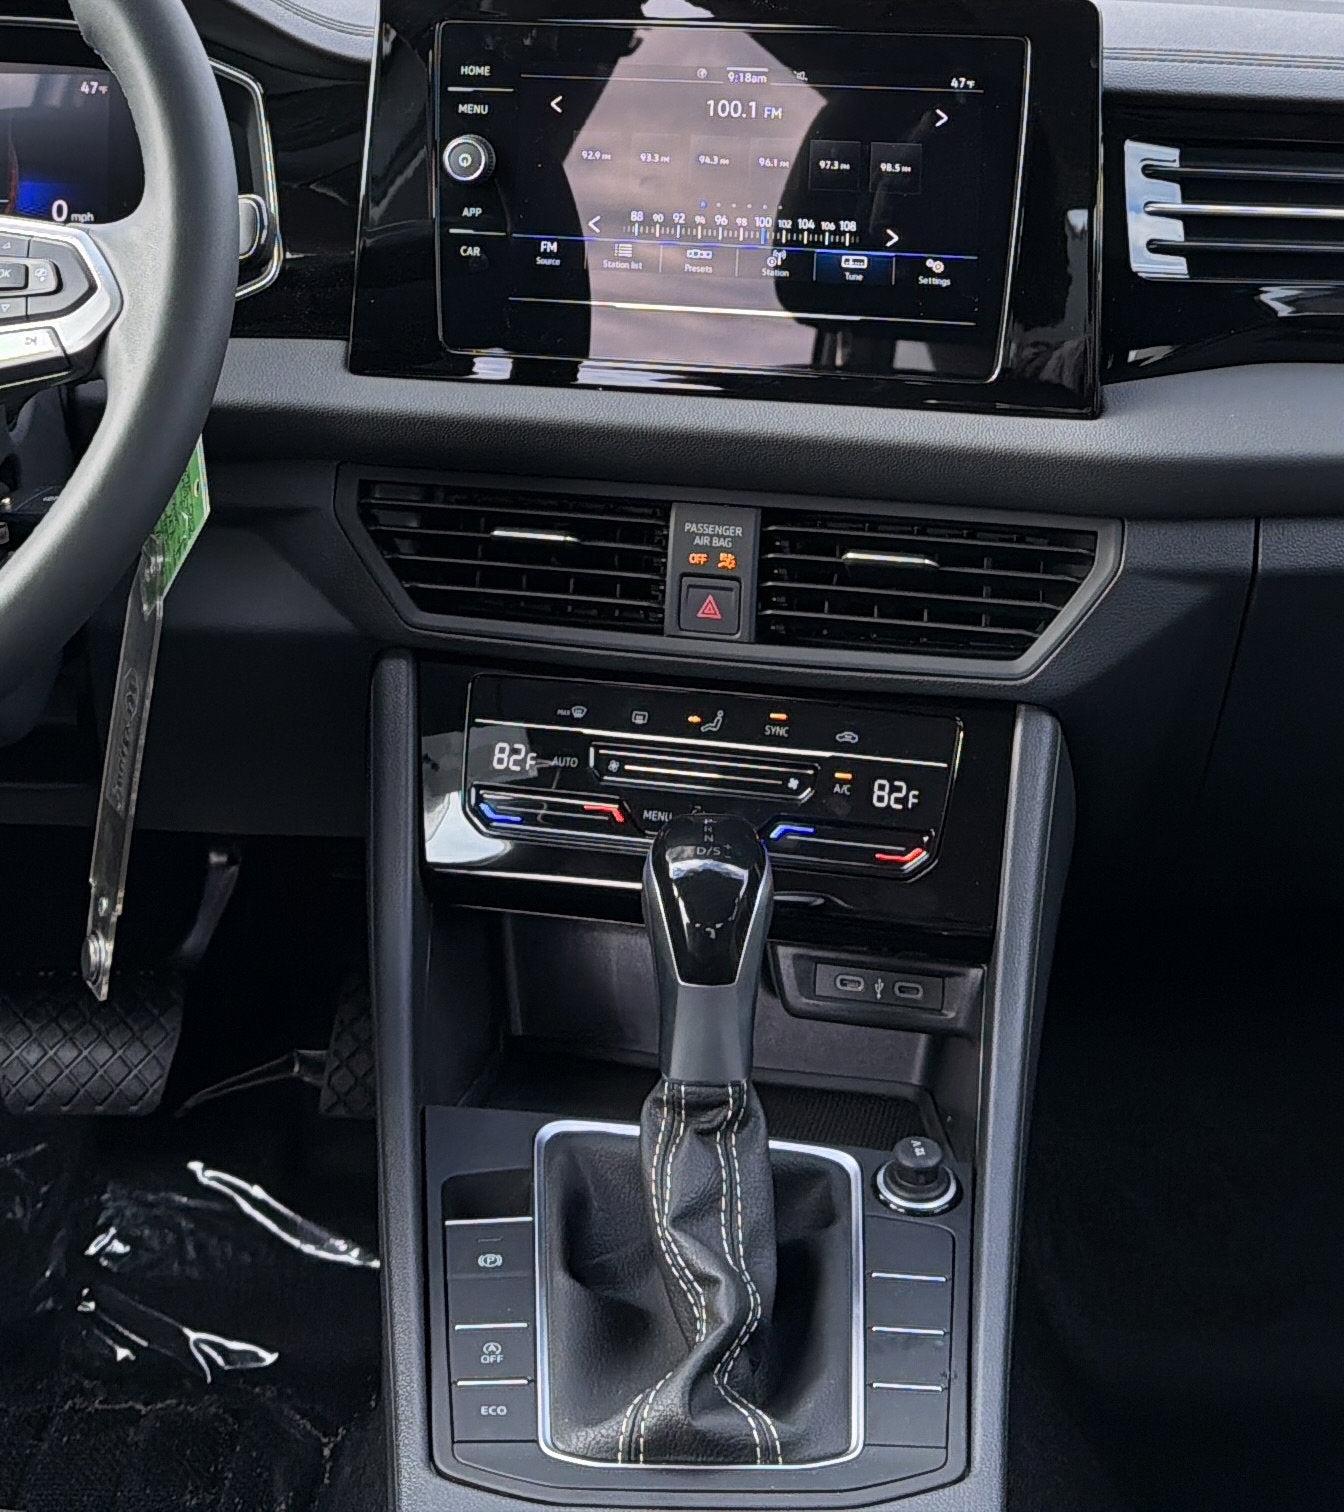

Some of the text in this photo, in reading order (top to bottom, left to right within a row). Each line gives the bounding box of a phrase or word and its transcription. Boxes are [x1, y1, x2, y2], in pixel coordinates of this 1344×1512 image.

[460, 65, 491, 76] HOME
[727, 72, 768, 84] 9:18am
[458, 103, 489, 115] MENU
[706, 98, 783, 120] 100.1 FM
[581, 150, 601, 161] 92.9
[640, 152, 660, 163] 93.3
[698, 154, 719, 165] 94.3
[758, 157, 778, 168] 96.1
[819, 160, 839, 170] 97.3
[880, 162, 900, 173] 98.5
[51, 199, 95, 223] 0 mph
[462, 206, 483, 218] APP
[630, 210, 857, 232] 88 90 92 94 96 98 100 102 104 106 108
[460, 244, 482, 258] CAR
[540, 241, 558, 253] FM
[536, 256, 561, 266] Source
[603, 259, 627, 269] Station
[684, 263, 713, 273] Presets
[761, 268, 790, 278] Station
[845, 271, 864, 281] Tune
[918, 276, 951, 288] Settings
[684, 522, 743, 537] PASSENGER
[693, 535, 732, 548] AIR BAG
[689, 552, 708, 565] OFF
[764, 724, 789, 738] SYNC
[551, 756, 579, 768] AUTO
[833, 783, 851, 796] A/C
[643, 809, 673, 823] MENU
[704, 834, 714, 842] N
[480, 1354, 504, 1364] OFF
[480, 1405, 508, 1416] ECO
